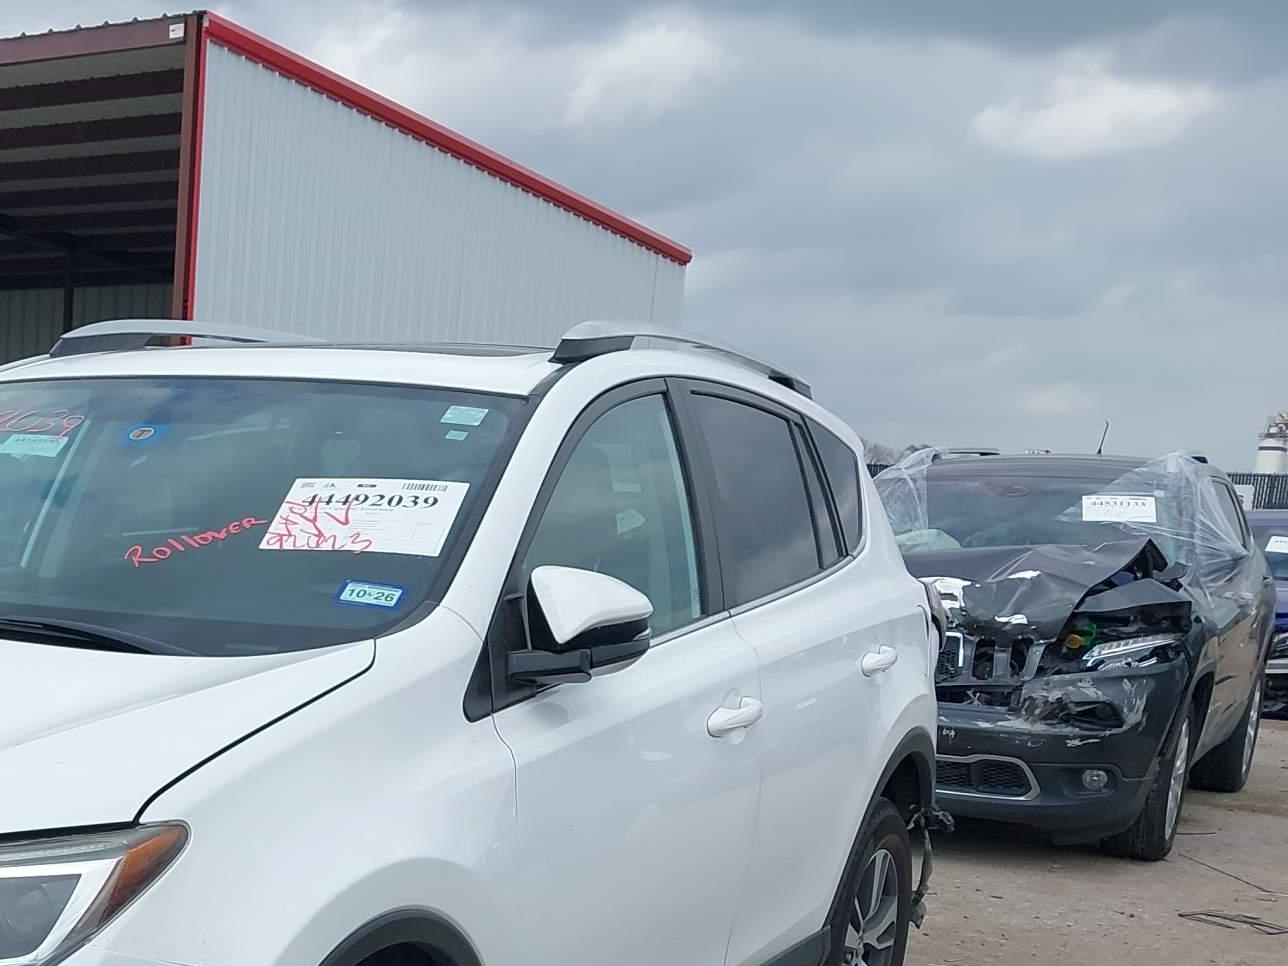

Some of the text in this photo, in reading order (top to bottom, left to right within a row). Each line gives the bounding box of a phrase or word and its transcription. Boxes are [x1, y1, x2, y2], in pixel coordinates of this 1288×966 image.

[302, 492, 439, 509] 44492039
[347, 588, 396, 603] 10 26
